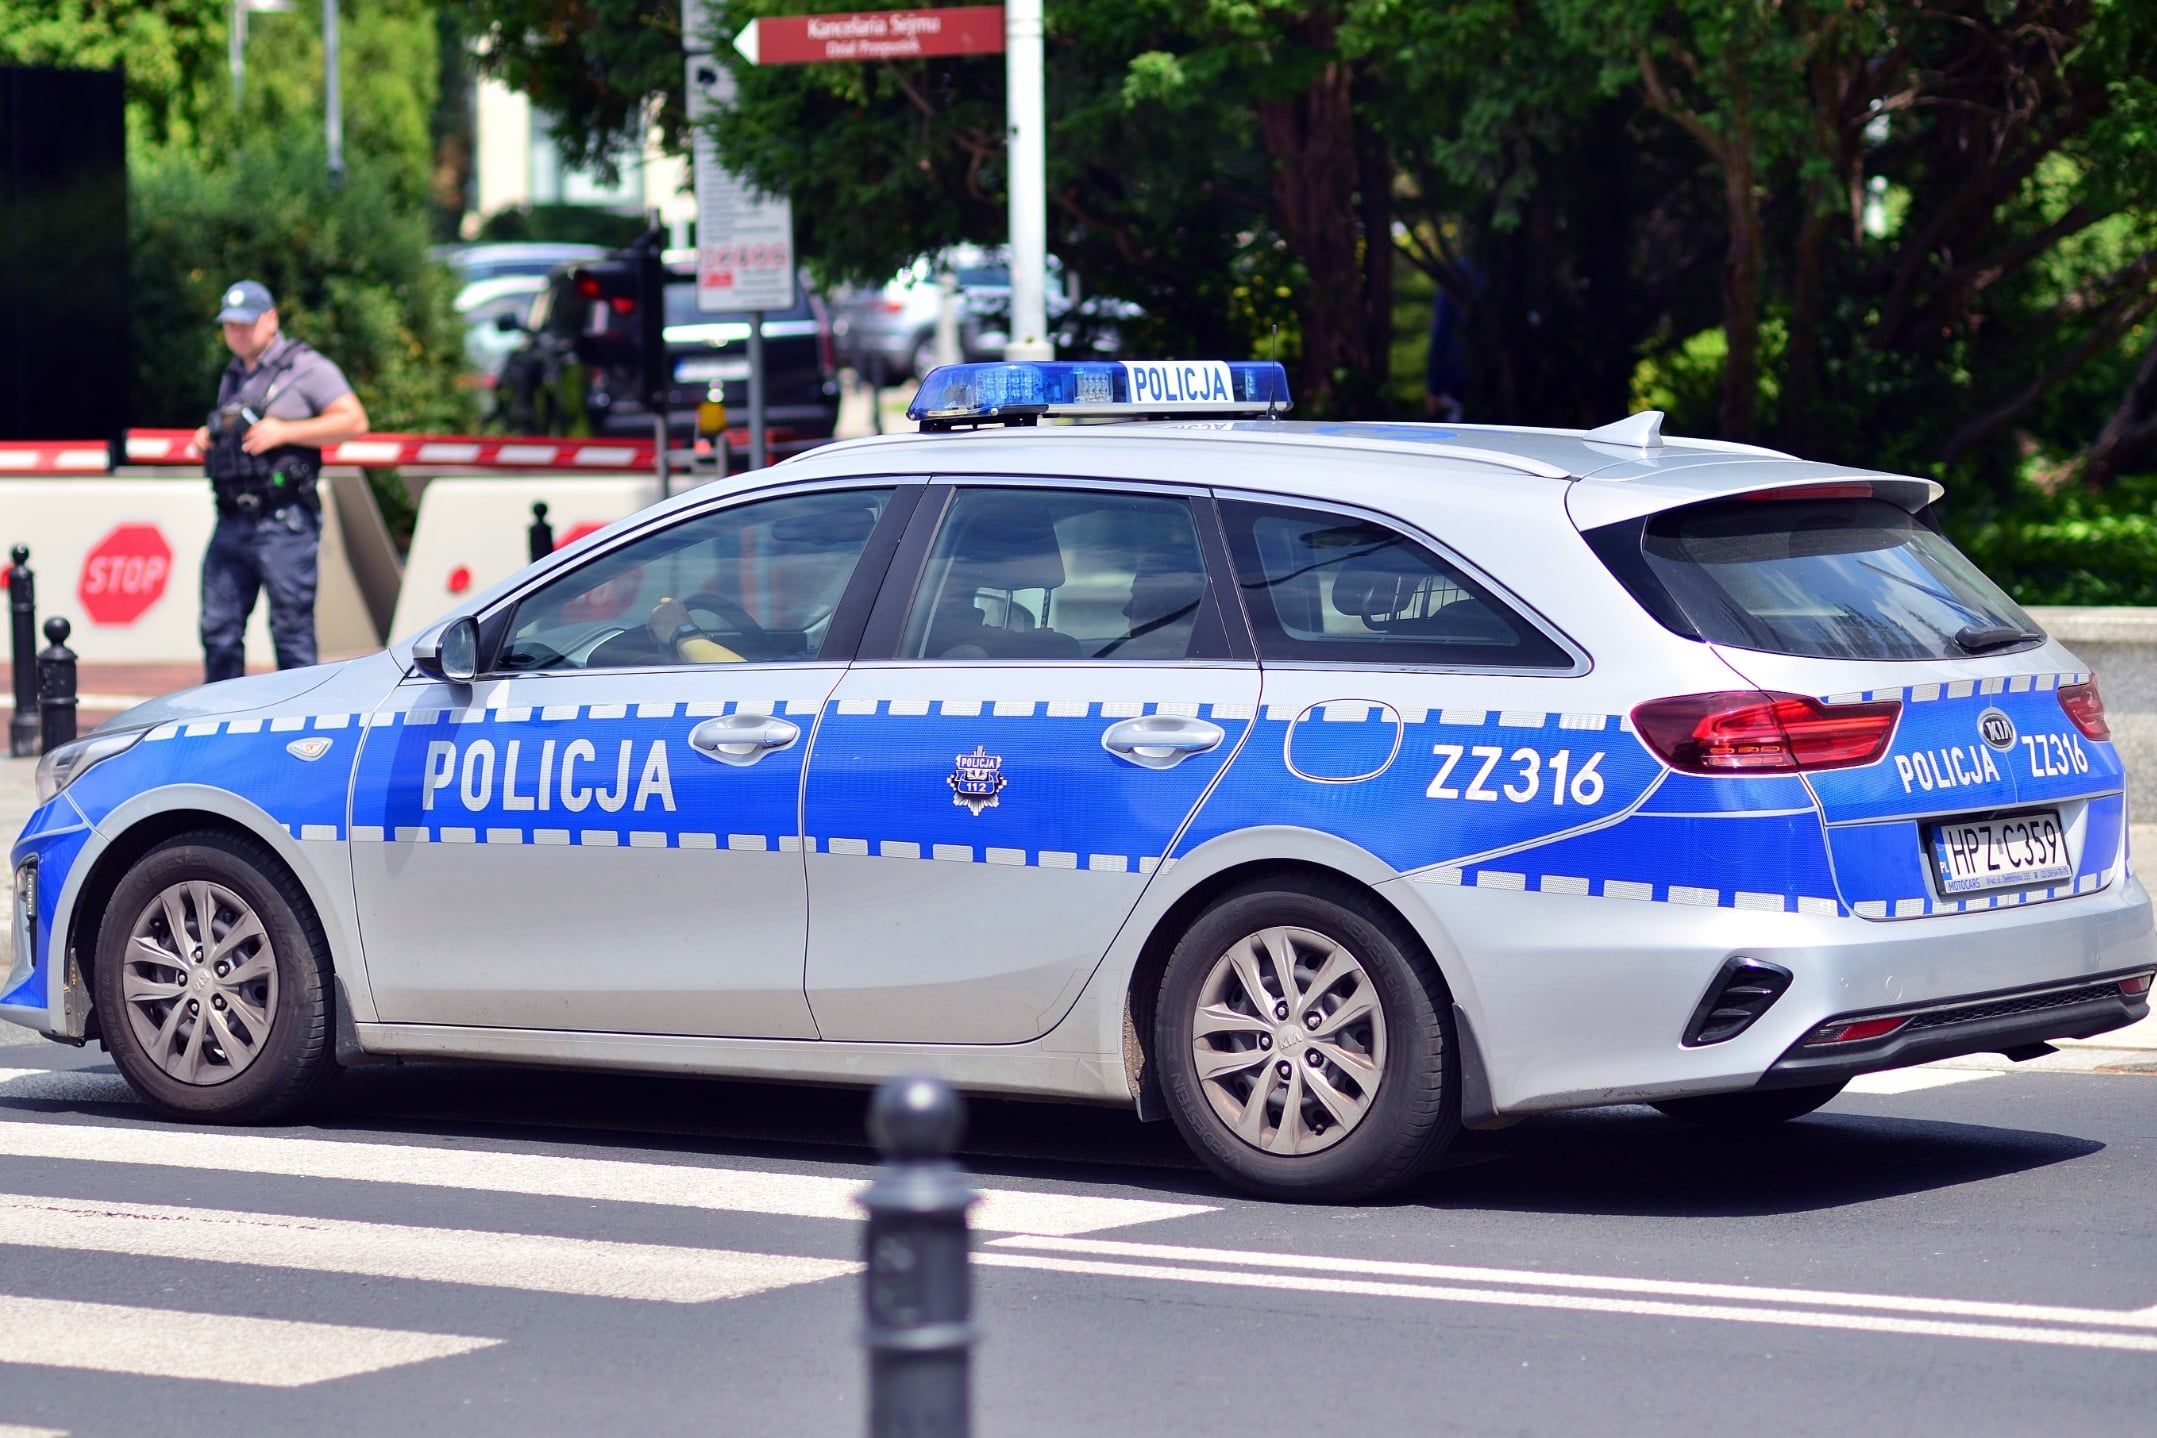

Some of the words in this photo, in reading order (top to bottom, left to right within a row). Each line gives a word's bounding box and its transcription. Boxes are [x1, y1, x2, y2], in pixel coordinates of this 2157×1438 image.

[807, 15, 887, 40] Kancelaria
[889, 12, 941, 38] Sejmu
[1133, 366, 1229, 402] POLICJA
[84, 555, 167, 595] STOP
[1986, 720, 2013, 741] KIA
[423, 739, 677, 812] POLICJA
[961, 757, 995, 768] POLICJA
[1426, 744, 1606, 805] ZZ316
[1894, 744, 2001, 793] POLICJA
[2021, 733, 2089, 778] ZZ316
[966, 782, 987, 792] 112
[1939, 862, 1950, 874] PL
[1948, 877, 1981, 892] MOTOCARS
